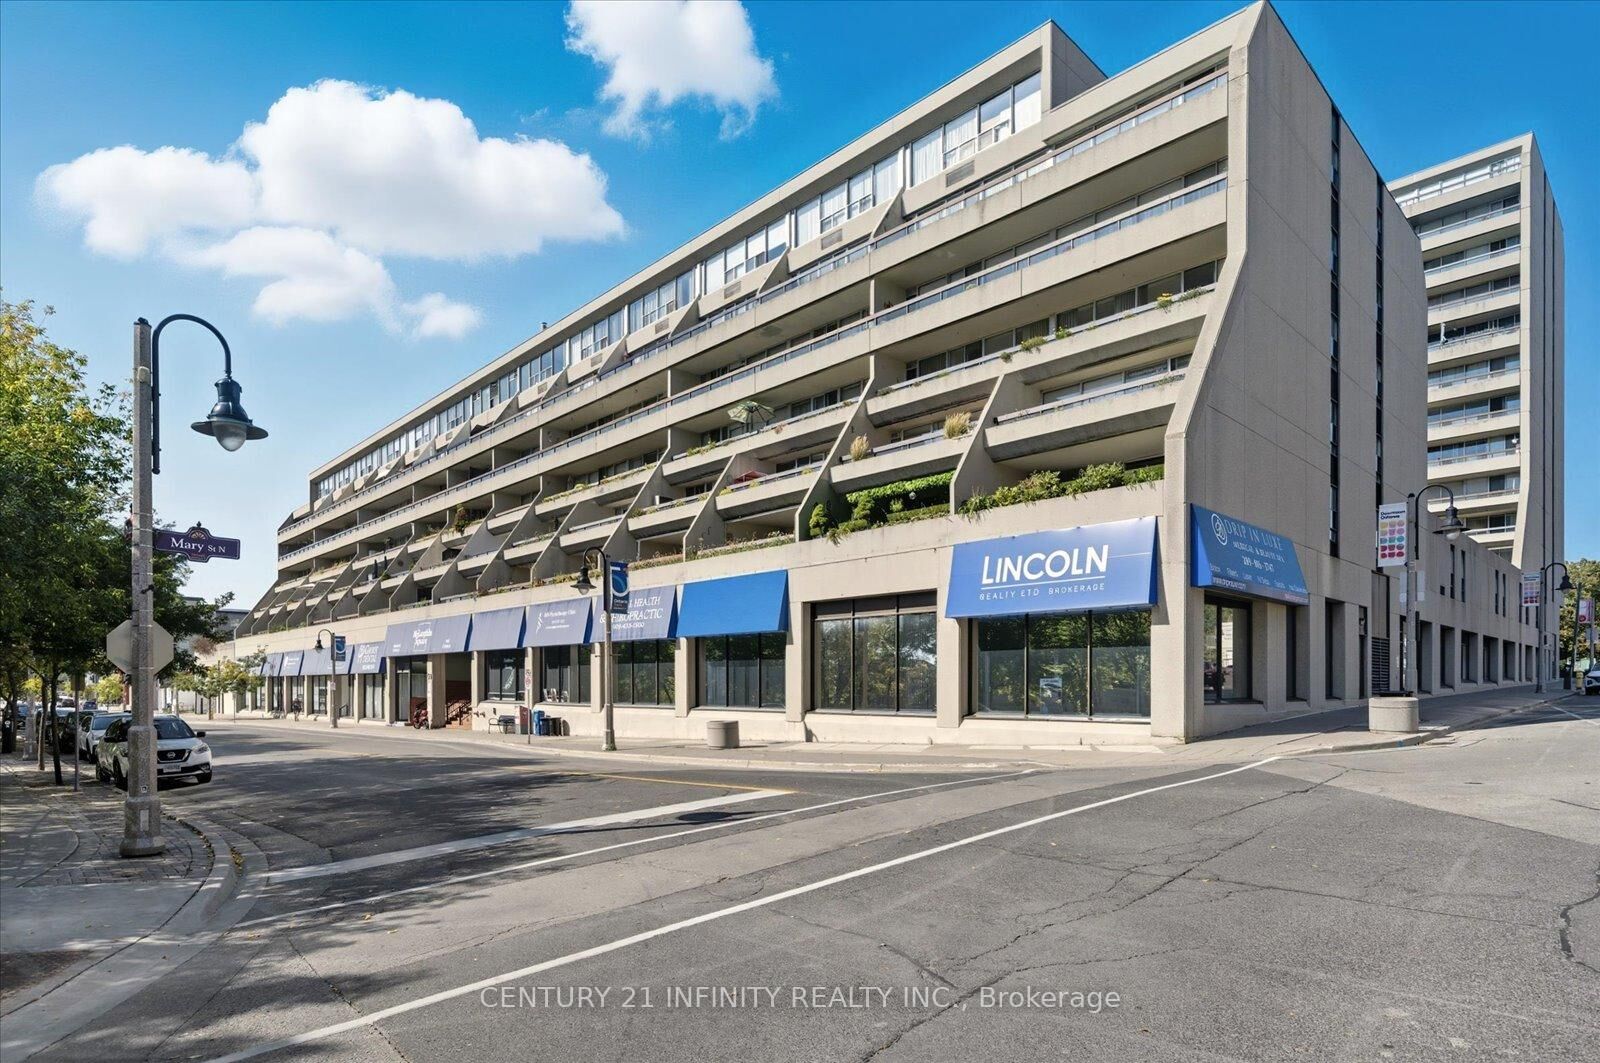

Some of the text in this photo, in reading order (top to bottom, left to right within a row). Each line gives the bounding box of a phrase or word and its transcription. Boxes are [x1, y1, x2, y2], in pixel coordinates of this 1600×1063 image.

[1224, 519, 1283, 551] DRIP IN LUXE
[170, 536, 226, 553] Mary St N
[981, 544, 1109, 585] LINCOLN
[979, 590, 1016, 601] REALTY
[1048, 582, 1105, 596] BROKERAGE
[633, 596, 661, 608] HEALTH
[611, 607, 664, 623] HIROPRACTIC
